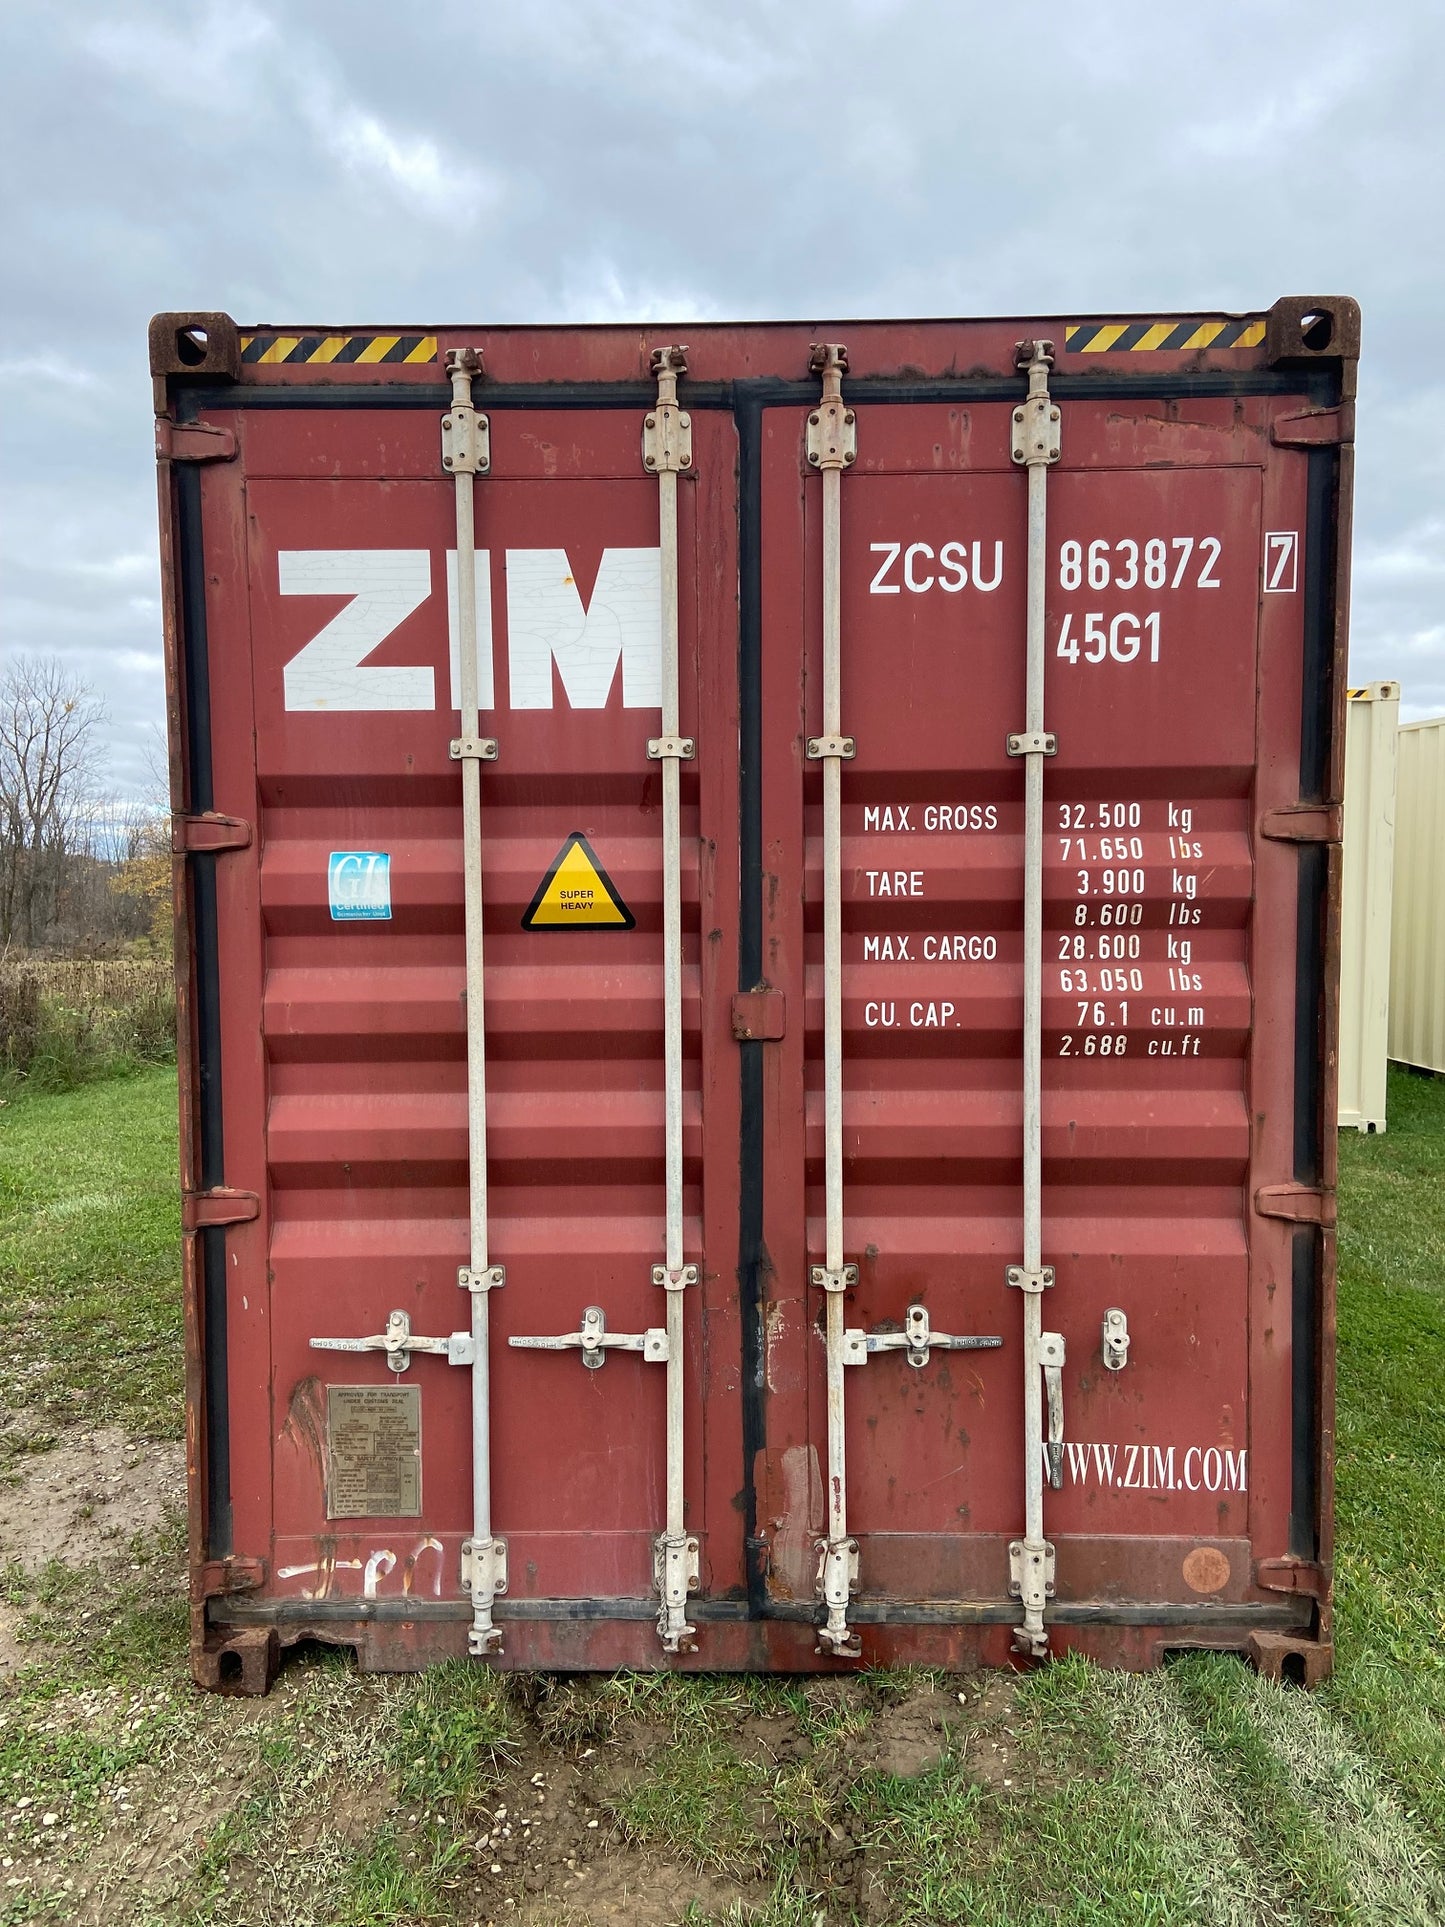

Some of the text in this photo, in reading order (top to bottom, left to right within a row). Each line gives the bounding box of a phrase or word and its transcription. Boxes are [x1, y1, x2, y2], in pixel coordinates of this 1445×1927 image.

[869, 536, 1294, 594] ZCSU 863872 7
[278, 547, 664, 712] ZIM
[1056, 611, 1161, 664] 45G1
[864, 805, 916, 831] MAX.
[924, 805, 998, 831] GROSS
[1168, 801, 1192, 834] kg
[1168, 836, 1203, 859] lbs
[560, 890, 594, 899] SUPER
[865, 871, 924, 897] TARE
[1172, 868, 1197, 900] kg
[560, 902, 594, 910] HEAVY
[1169, 902, 1202, 925] lbs
[864, 935, 915, 961] MAX.
[923, 935, 997, 961] CARGO
[1167, 933, 1191, 966] kg
[1168, 967, 1203, 992] lbs
[865, 1001, 1204, 1027] CU. CAP. 76.1 cu.m
[1148, 1034, 1201, 1056] cu.ft
